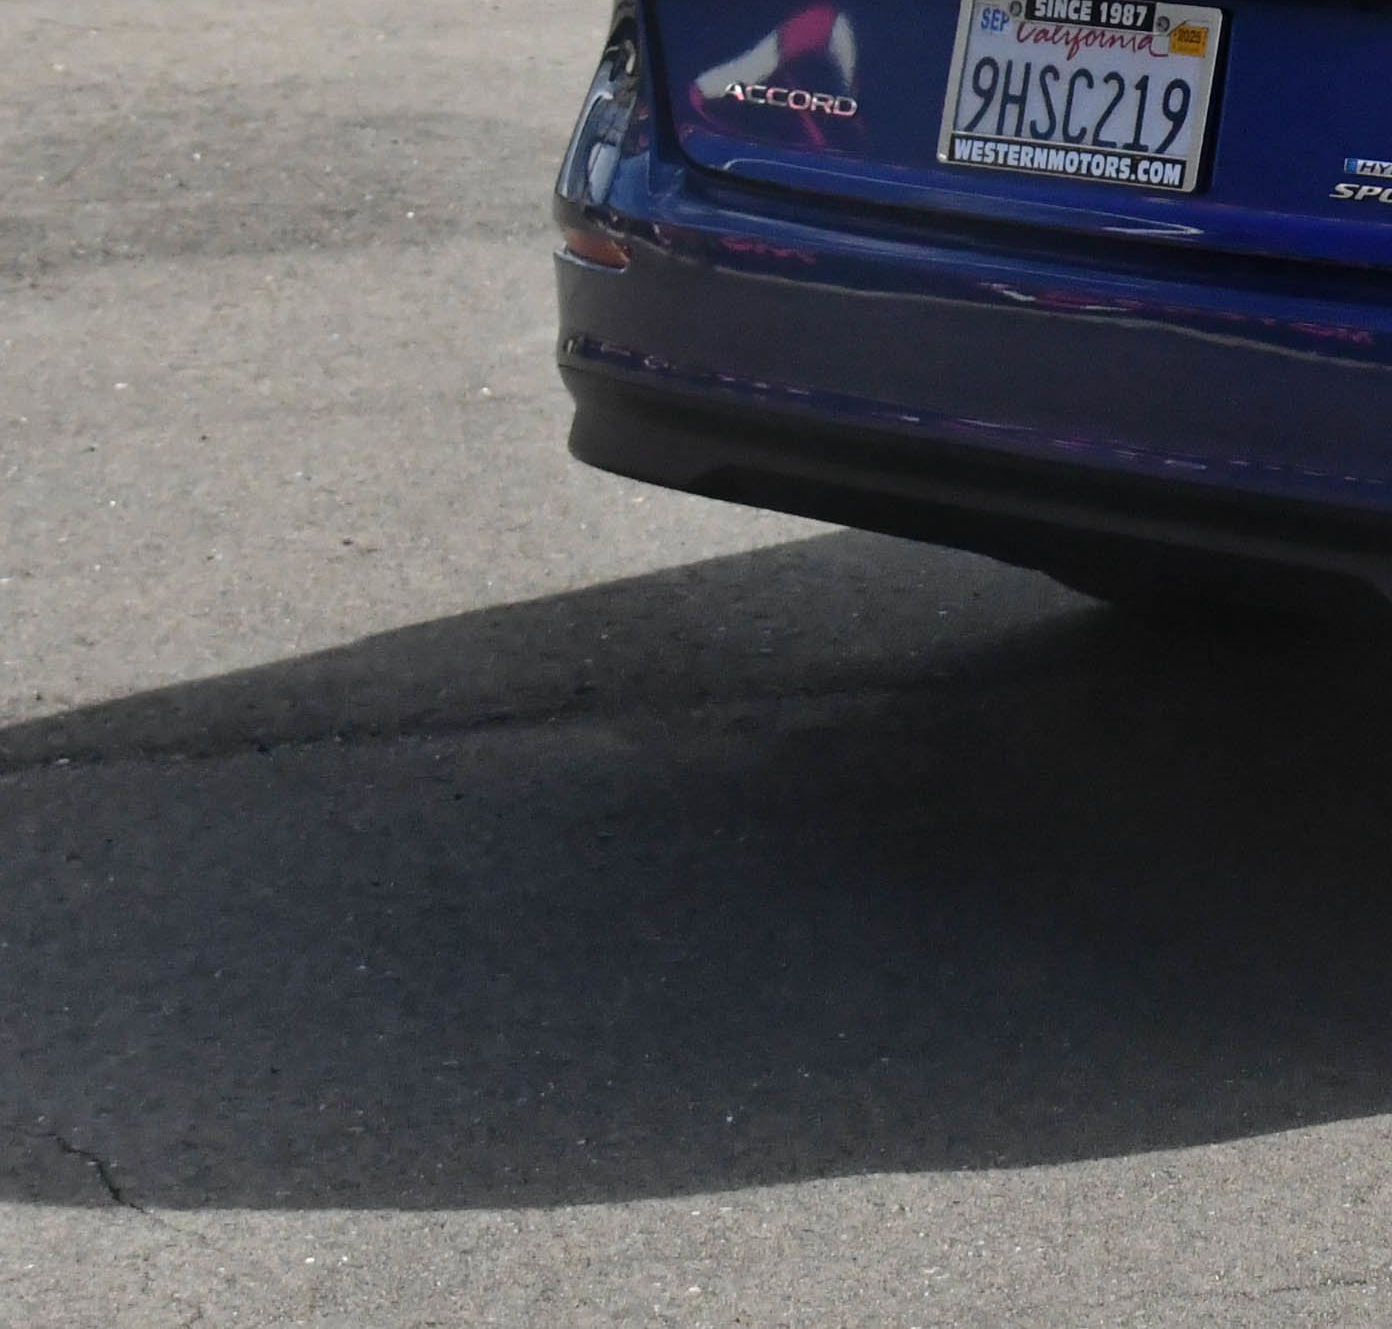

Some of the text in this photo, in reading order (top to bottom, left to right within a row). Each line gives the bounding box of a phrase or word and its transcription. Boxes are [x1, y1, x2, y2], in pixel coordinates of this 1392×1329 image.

[980, 7, 1010, 32] SEP
[1099, 1, 1149, 28] 1987
[1016, 21, 1169, 61] California
[724, 81, 858, 117] ACCORD
[964, 55, 1192, 155] 9HSC219
[953, 137, 1182, 186] WESTERNMOTORS.COM
